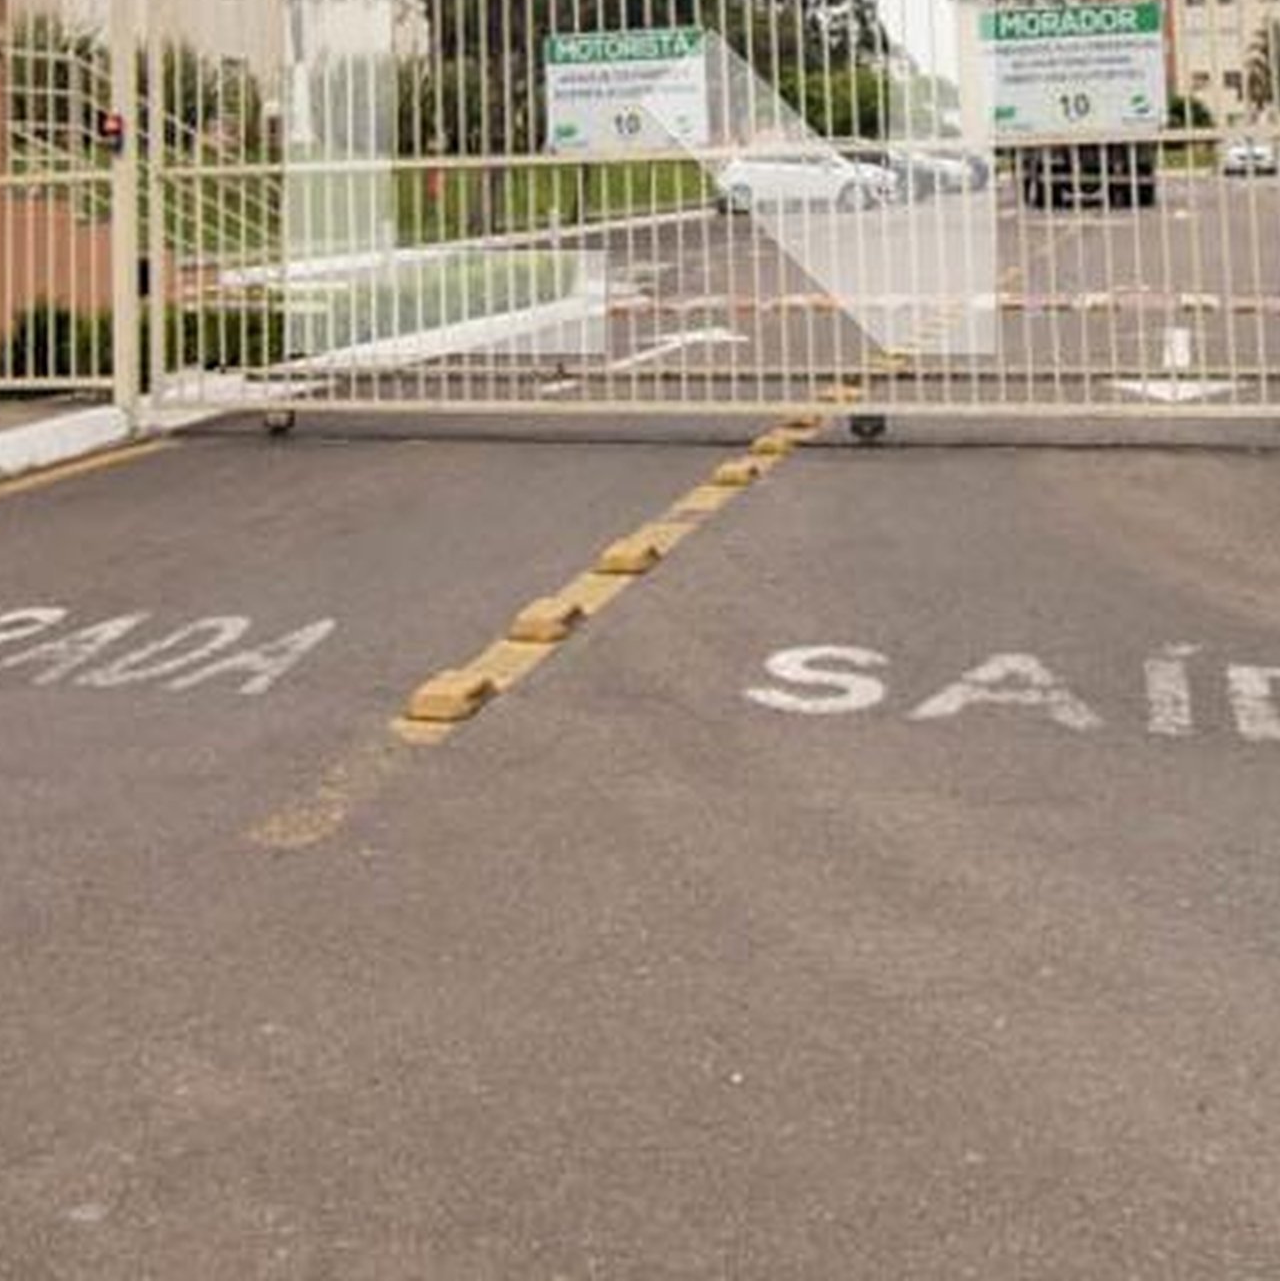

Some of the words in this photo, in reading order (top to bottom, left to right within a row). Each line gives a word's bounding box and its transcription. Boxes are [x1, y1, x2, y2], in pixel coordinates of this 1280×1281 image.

[999, 7, 1139, 37] MORADOR
[554, 31, 694, 62] MOTORISTA
[1059, 93, 1090, 118] 10
[613, 110, 642, 135] 10
